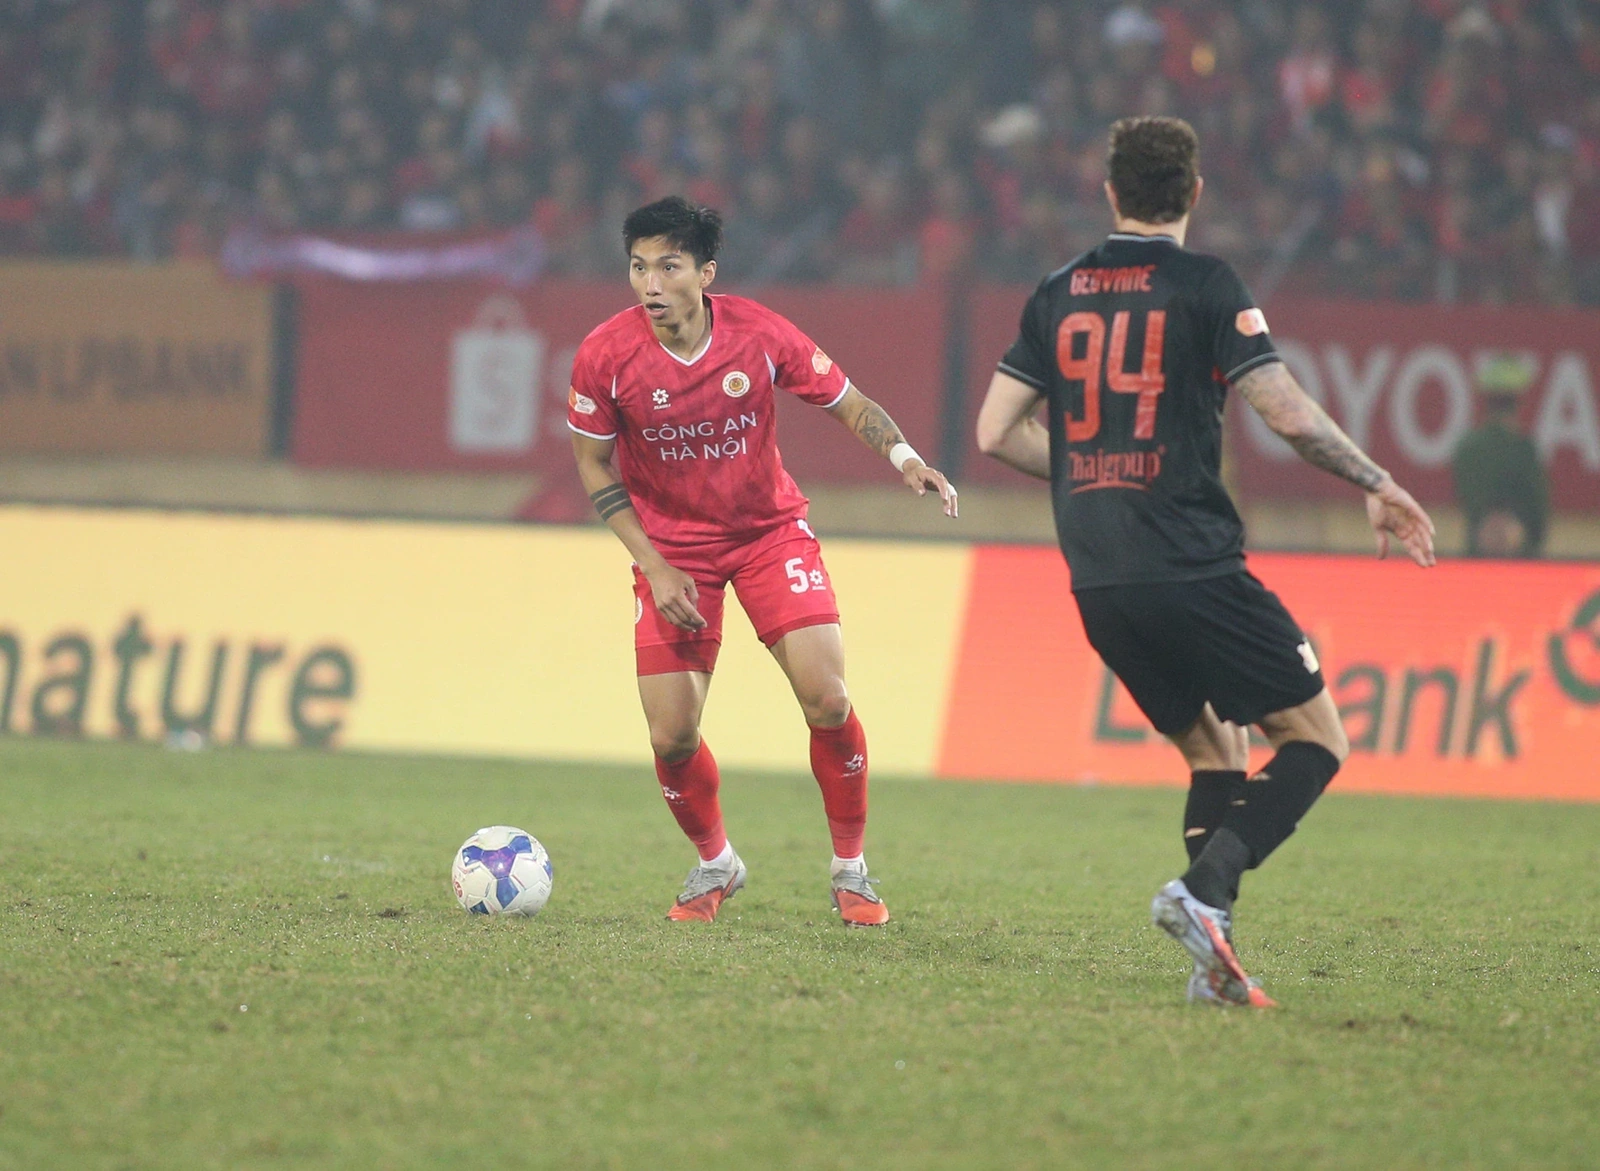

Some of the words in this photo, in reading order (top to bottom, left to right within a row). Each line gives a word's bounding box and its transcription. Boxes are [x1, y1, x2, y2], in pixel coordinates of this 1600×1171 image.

[1056, 310, 1167, 443] 94
[1239, 338, 1600, 472] OYOA
[642, 423, 714, 442] CÔNG
[723, 411, 757, 434] AN
[660, 442, 697, 461] HÀ
[703, 436, 747, 460] NỘI
[784, 557, 809, 594] 5
[1092, 632, 1533, 761] Lank
